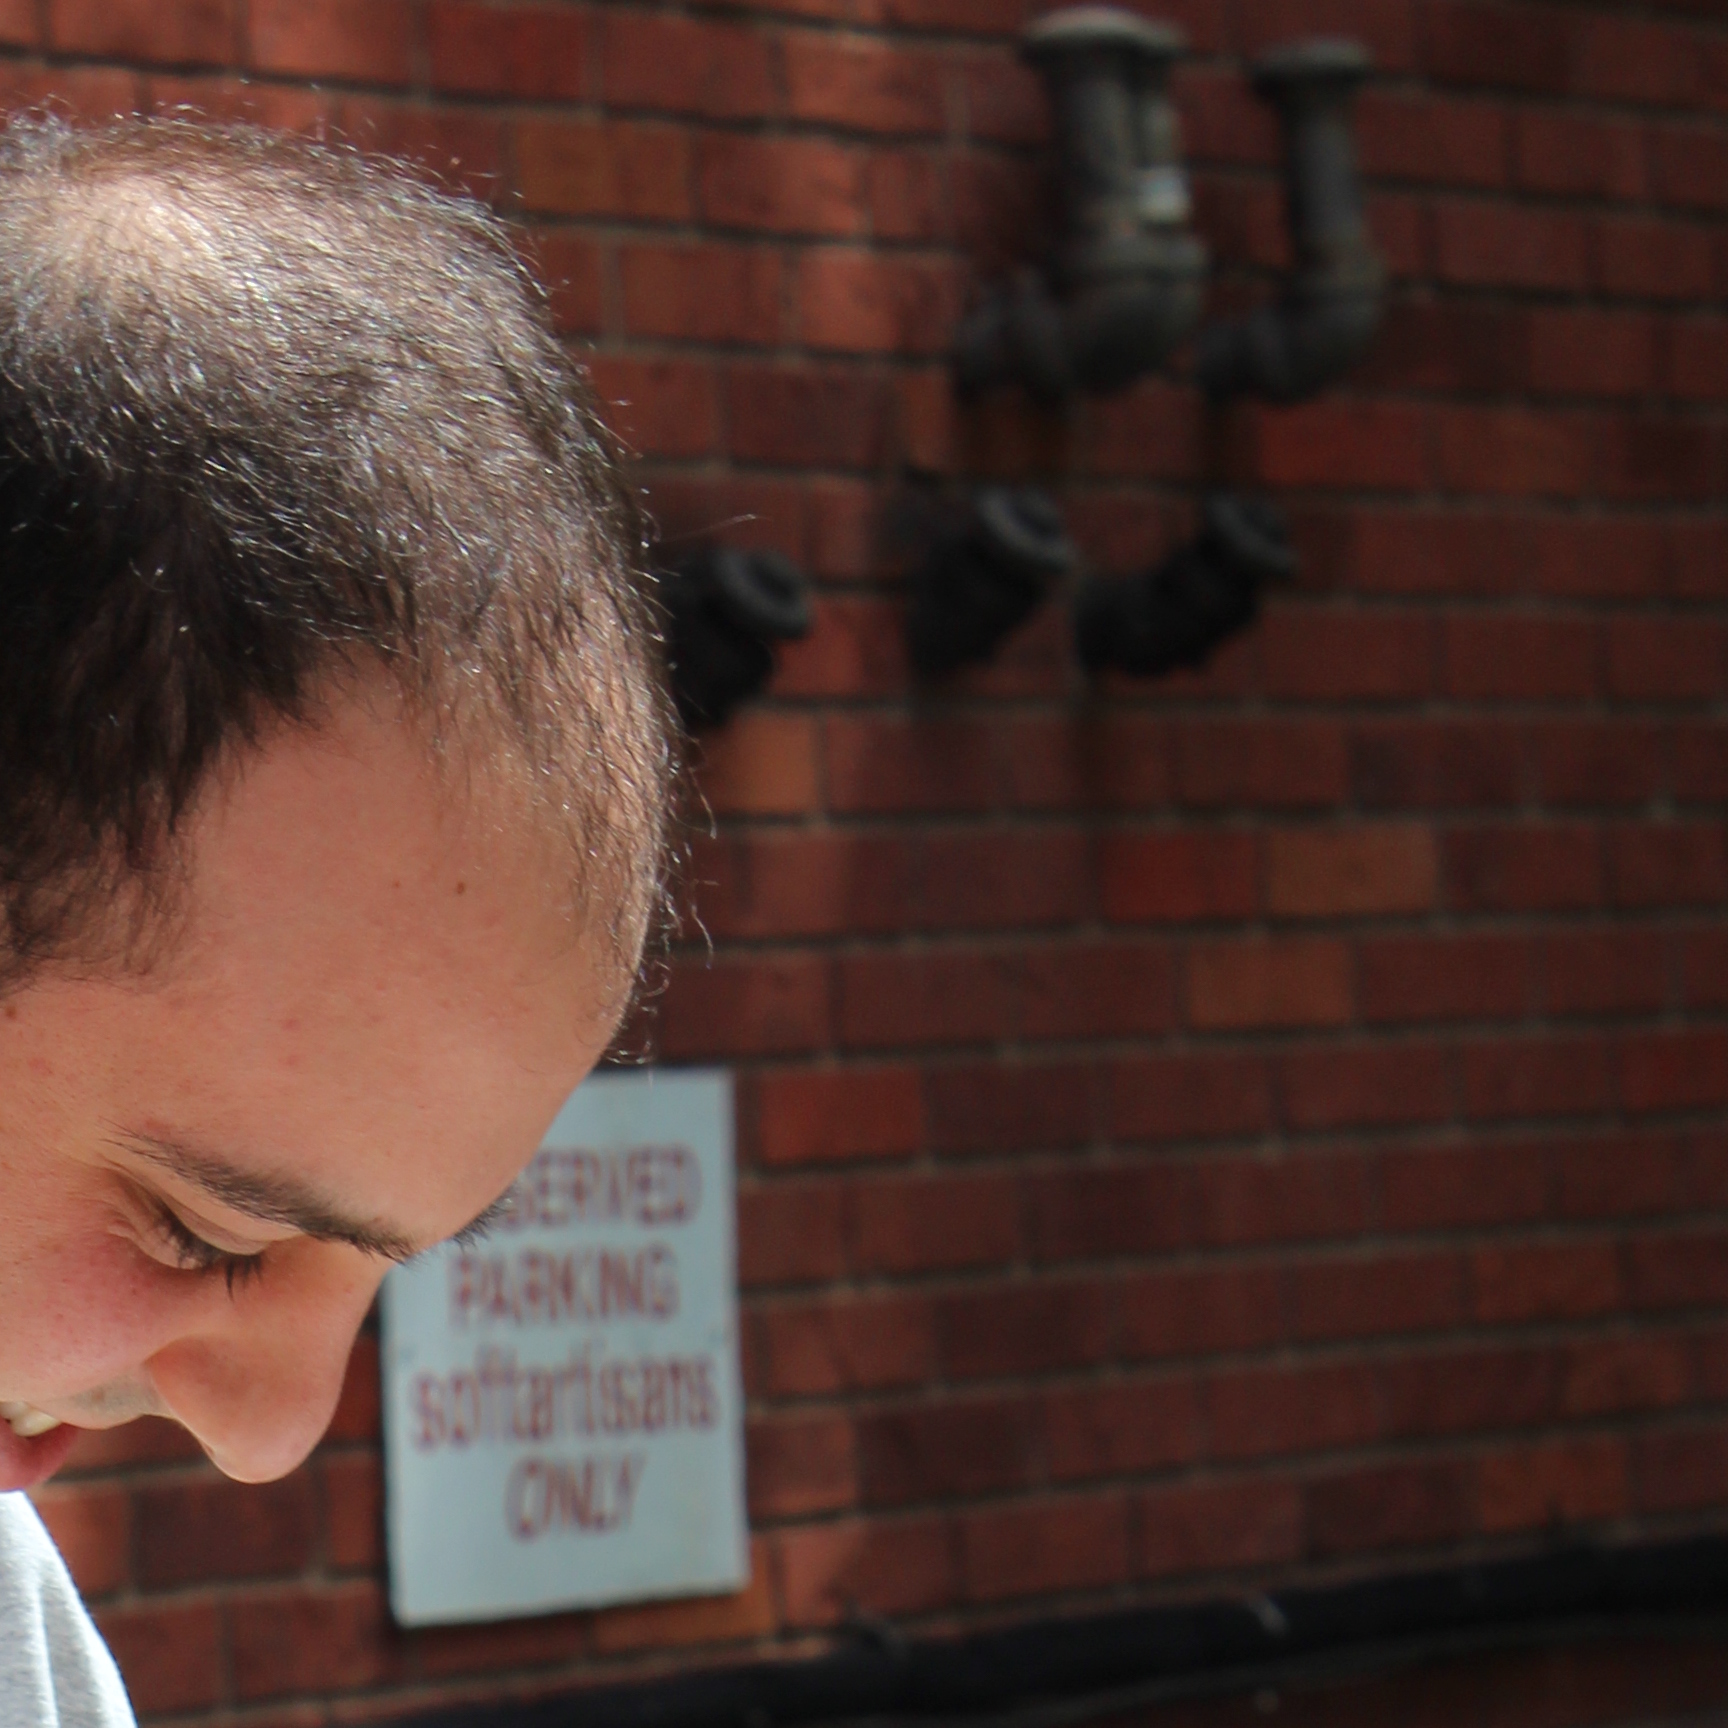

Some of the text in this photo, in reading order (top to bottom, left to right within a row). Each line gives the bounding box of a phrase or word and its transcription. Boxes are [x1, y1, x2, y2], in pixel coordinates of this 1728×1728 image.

[498, 1144, 702, 1231] SERVED
[446, 1243, 680, 1334] PARKING
[504, 1451, 646, 1542] ONLY
